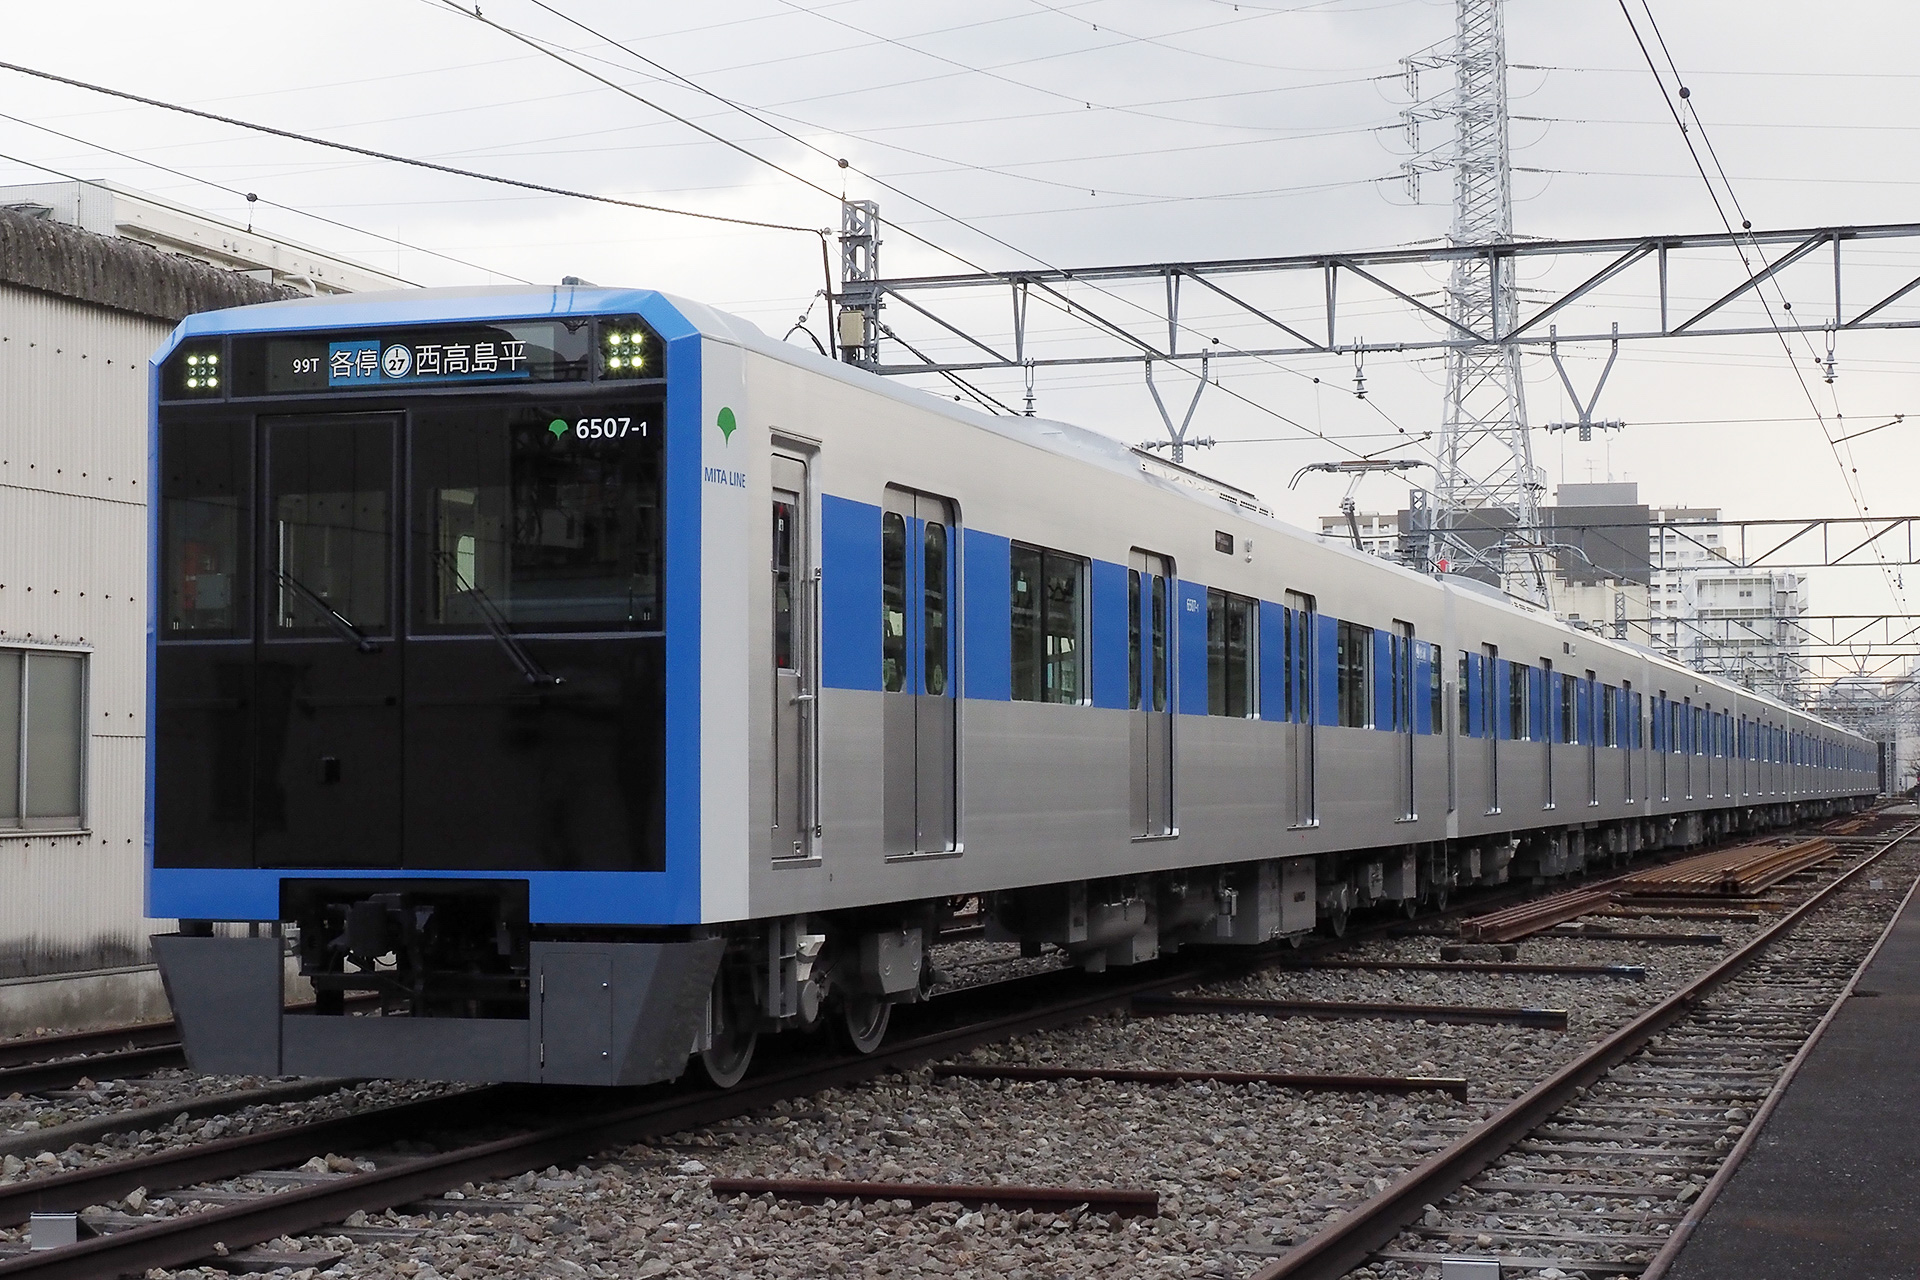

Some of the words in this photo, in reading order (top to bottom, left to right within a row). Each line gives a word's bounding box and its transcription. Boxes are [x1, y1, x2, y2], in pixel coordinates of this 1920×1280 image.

[292, 357, 320, 374] 99T
[330, 349, 379, 378] 各停
[388, 358, 406, 373] 27
[415, 340, 528, 376] 西高島平
[575, 418, 647, 439] 6507-1
[704, 466, 728, 485] MITA
[729, 472, 746, 488] LINE
